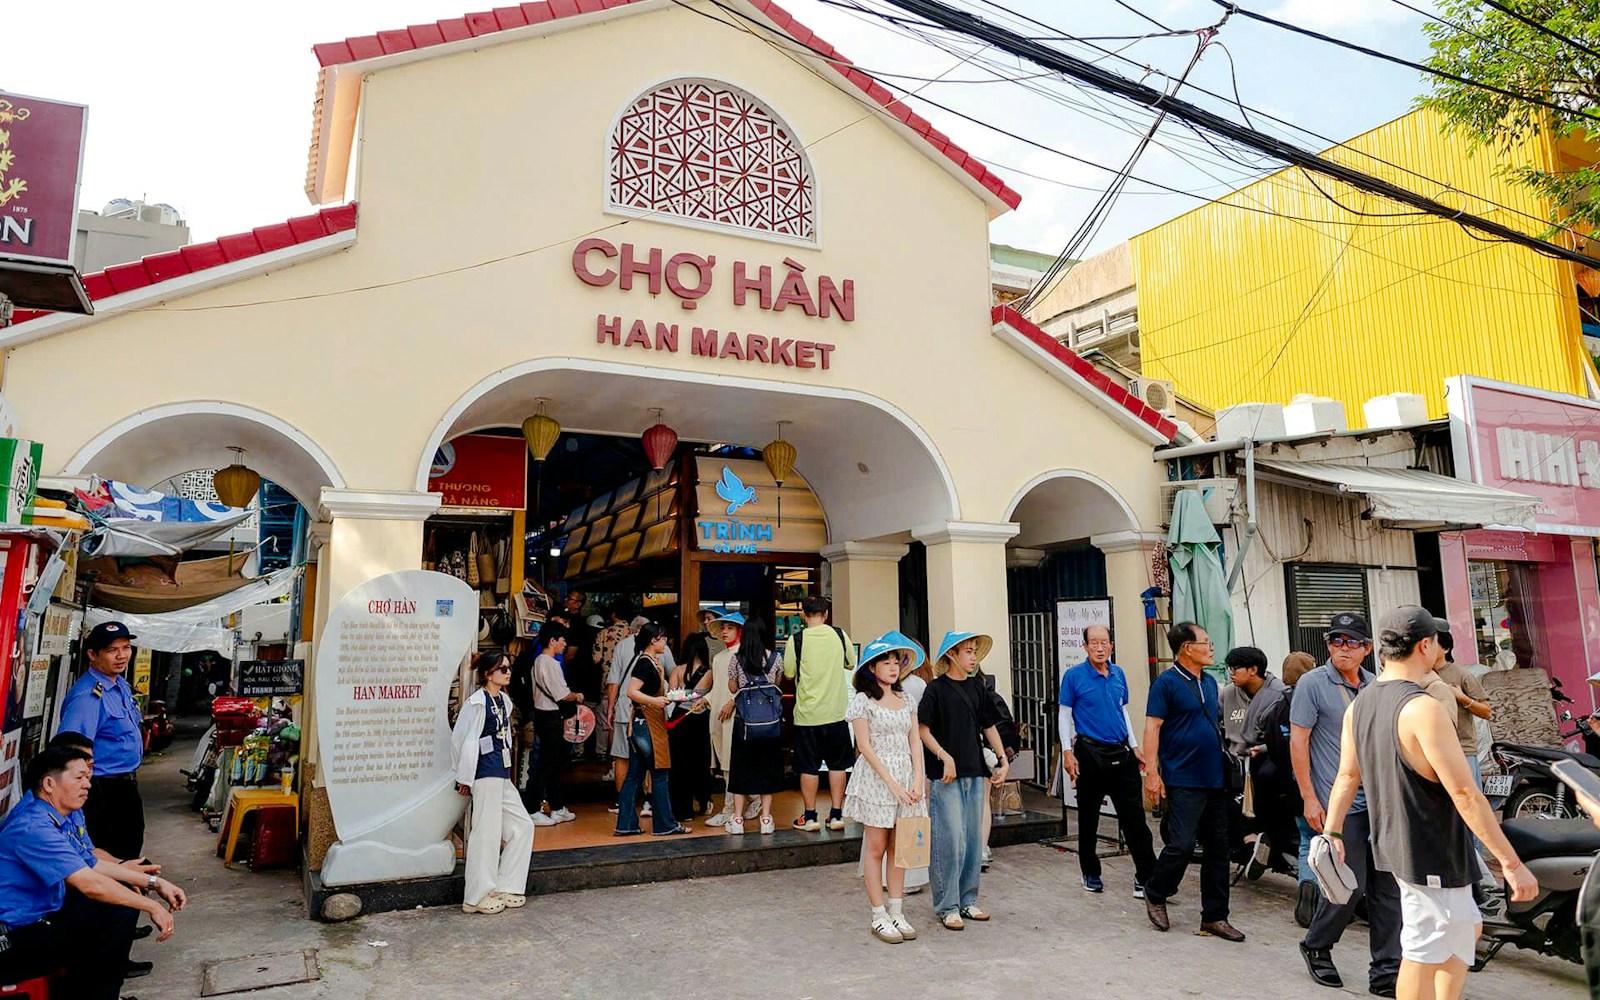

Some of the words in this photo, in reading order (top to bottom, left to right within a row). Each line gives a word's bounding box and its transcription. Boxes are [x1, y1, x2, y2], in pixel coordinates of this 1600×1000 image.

[0, 215, 33, 244] N
[572, 238, 716, 309] CHỢ
[733, 257, 855, 321] HÀN
[597, 314, 679, 352] HAN
[691, 327, 835, 370] MARKET
[698, 518, 773, 541] TRÌNH
[368, 598, 391, 616] CHỢ
[394, 597, 416, 614] HÀN
[353, 686, 376, 700] HAN
[378, 685, 422, 699] MARKET
